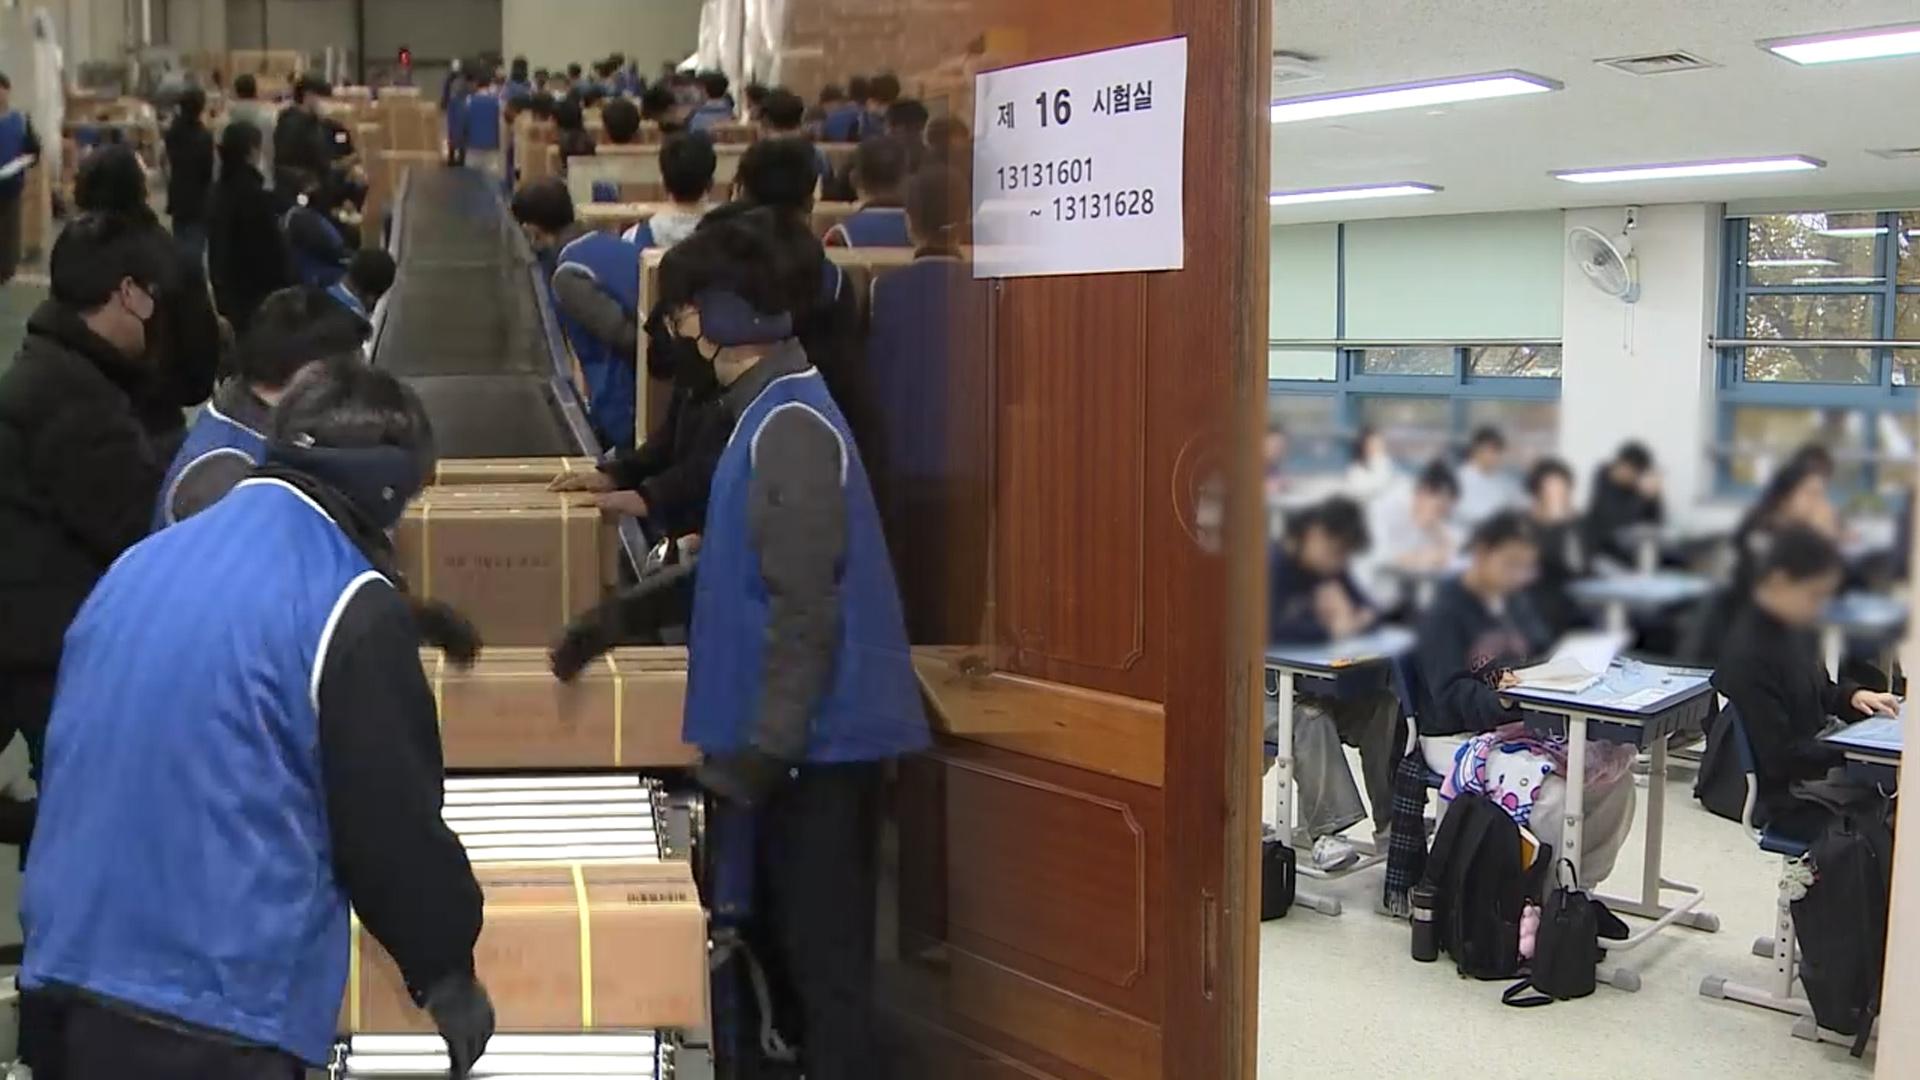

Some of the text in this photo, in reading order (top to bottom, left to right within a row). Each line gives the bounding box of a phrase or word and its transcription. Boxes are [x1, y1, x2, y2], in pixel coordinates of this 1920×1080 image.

[997, 80, 1153, 129] 제 16 시험실
[997, 157, 1093, 190] 13131601
[1053, 188, 1155, 221] 13131628
